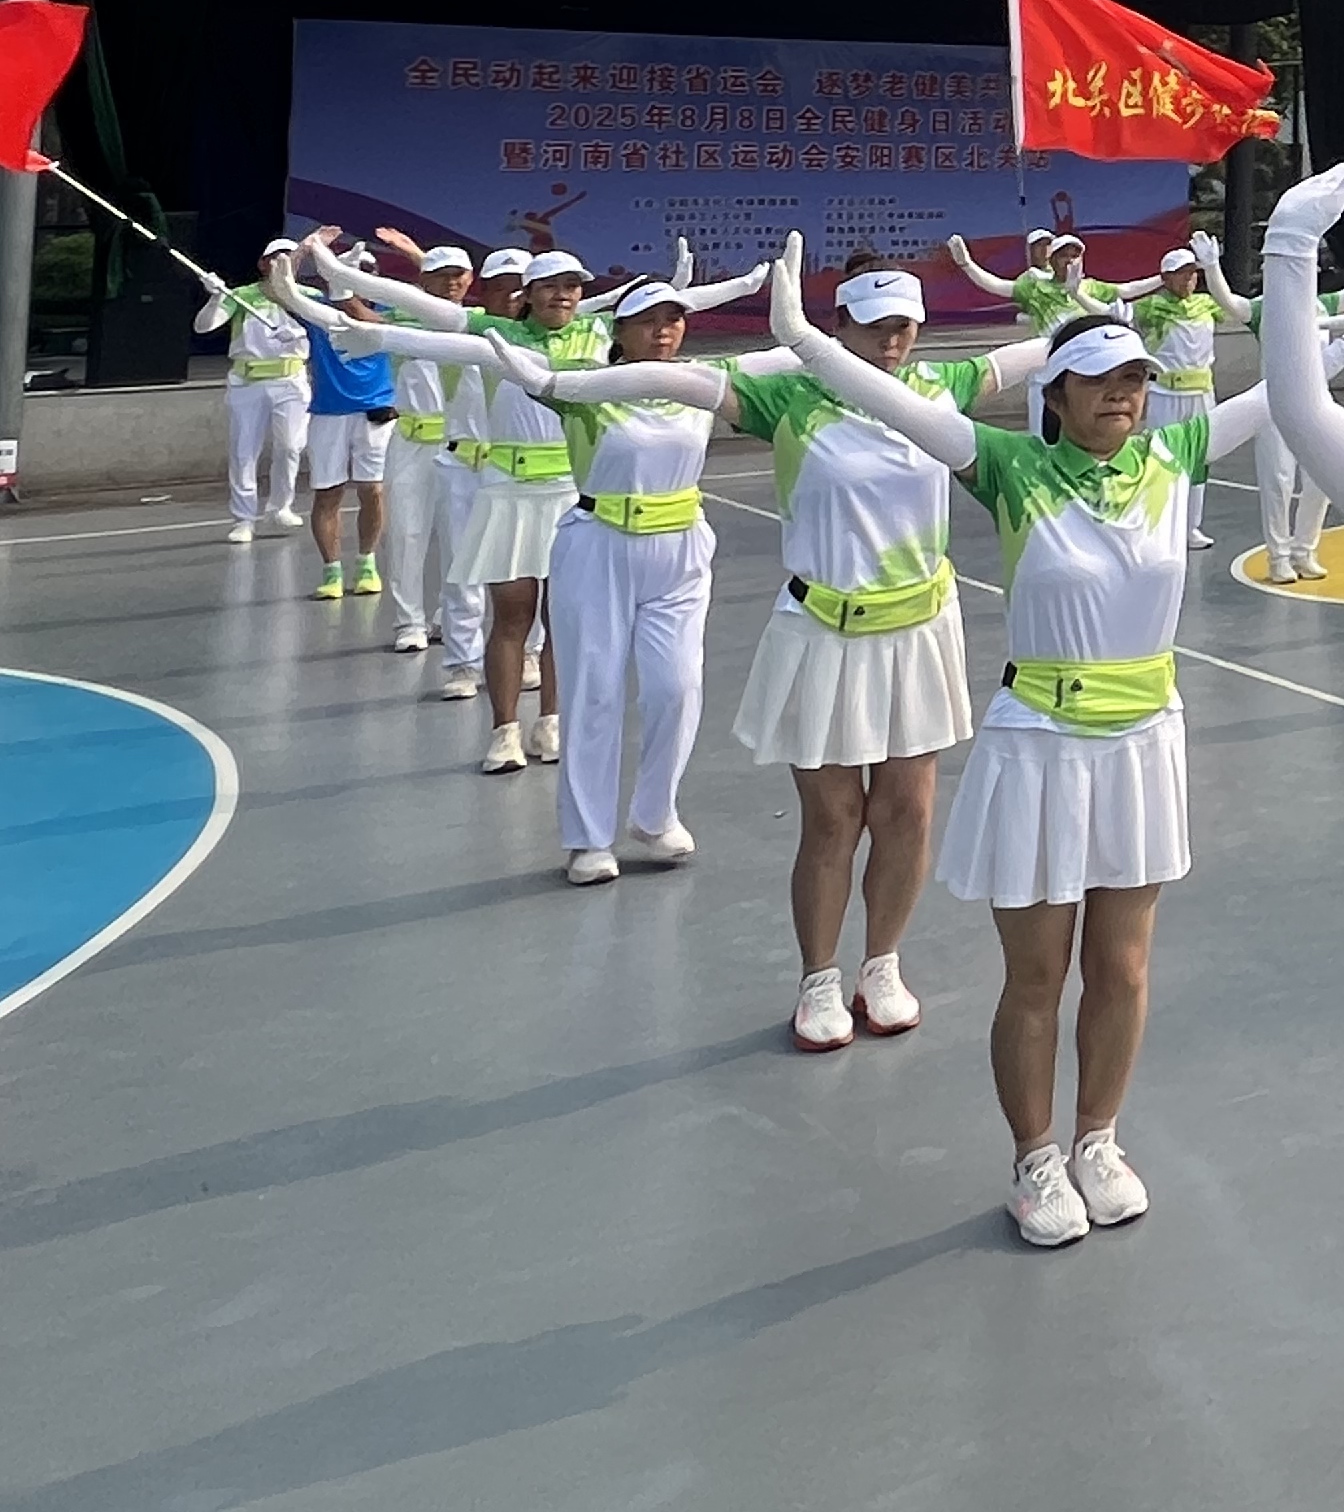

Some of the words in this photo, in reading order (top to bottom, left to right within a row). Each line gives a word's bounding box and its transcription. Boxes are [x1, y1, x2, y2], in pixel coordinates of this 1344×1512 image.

[405, 57, 785, 98] 全民动起来迎接省运会
[501, 140, 1051, 172] 暨河南省社区运动会安阳赛区北关站
